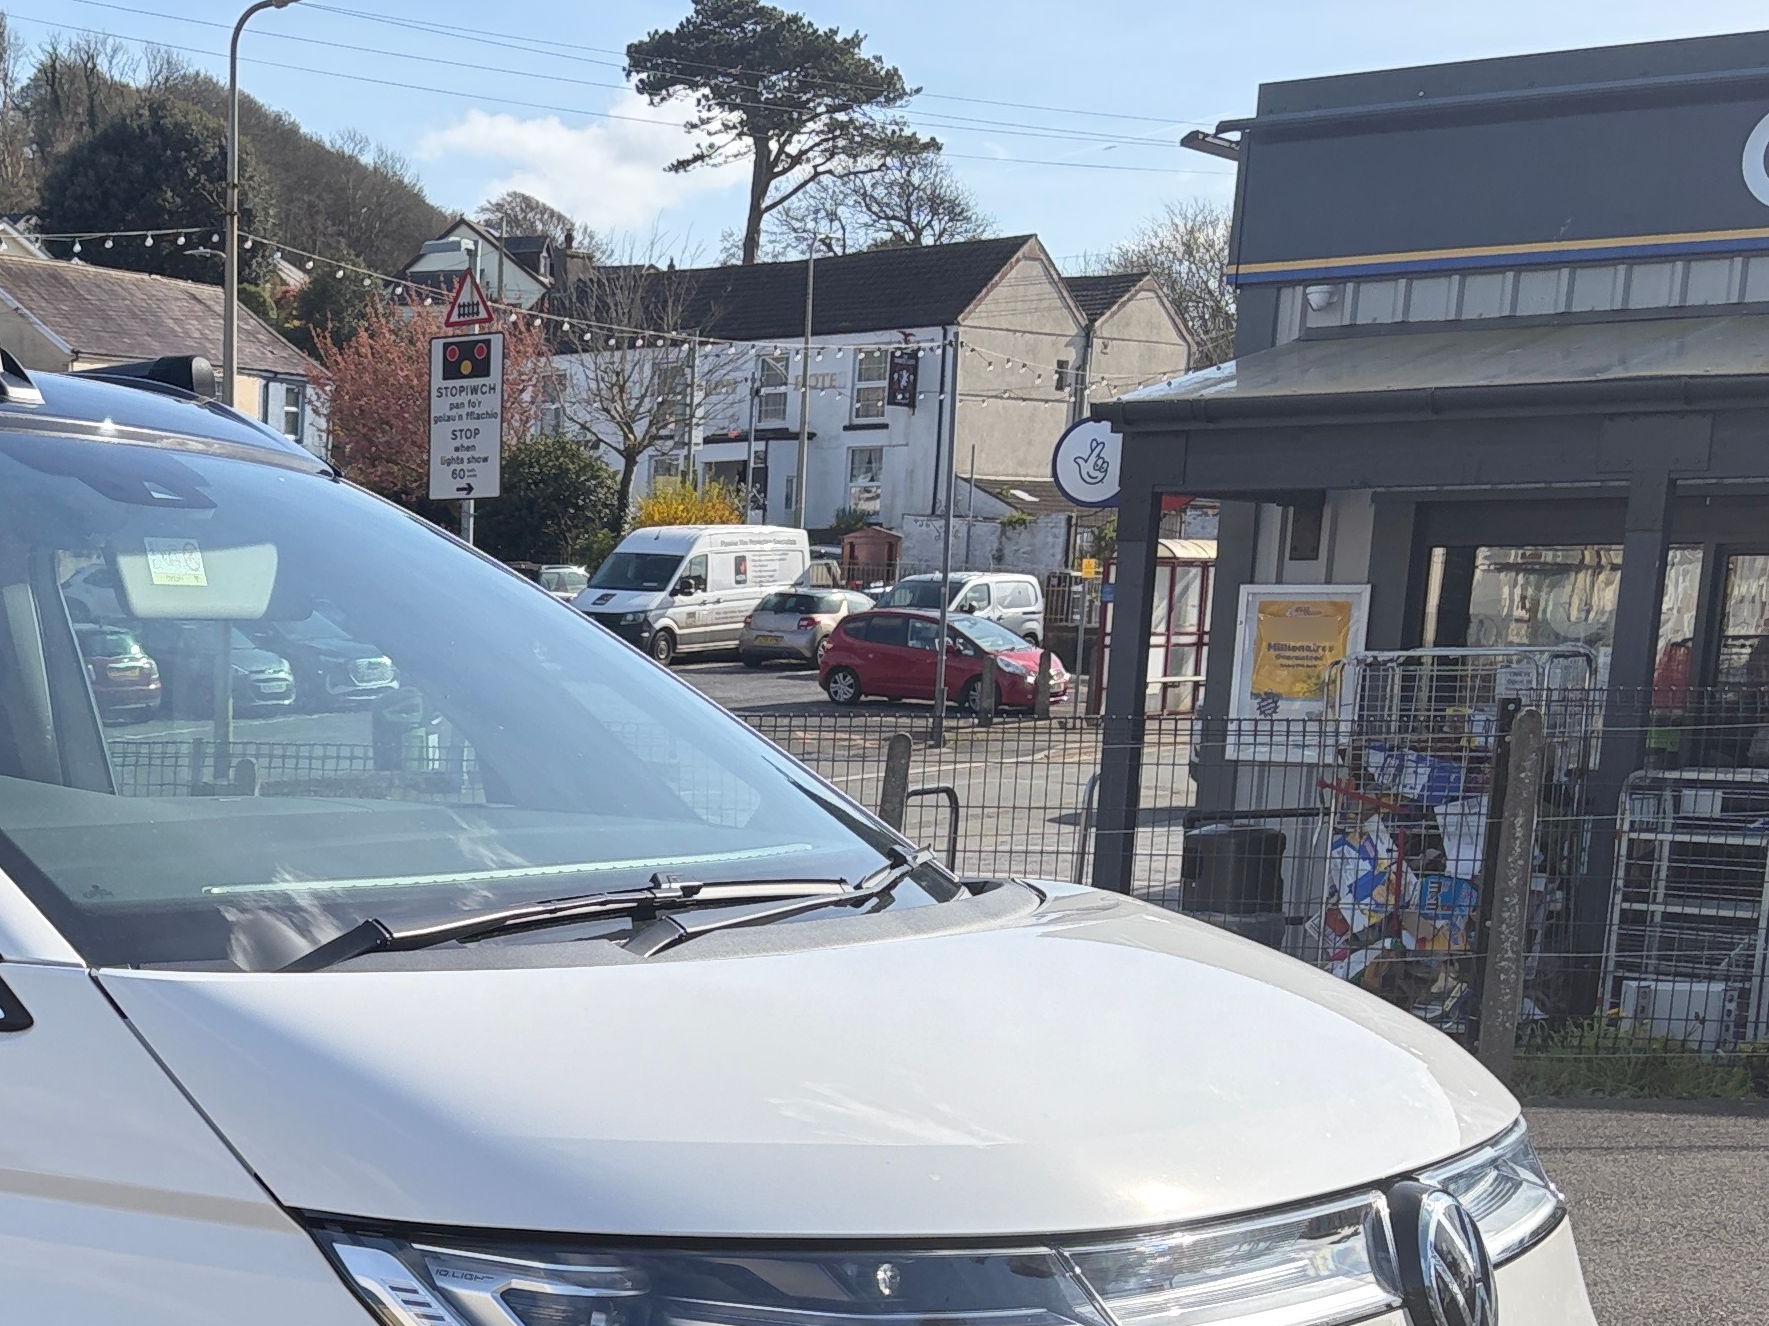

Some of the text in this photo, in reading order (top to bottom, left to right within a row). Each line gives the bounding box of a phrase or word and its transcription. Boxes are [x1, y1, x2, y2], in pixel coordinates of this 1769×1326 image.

[435, 383, 497, 399] STOPIWCH
[450, 428, 480, 441] STOP
[453, 443, 476, 452] when
